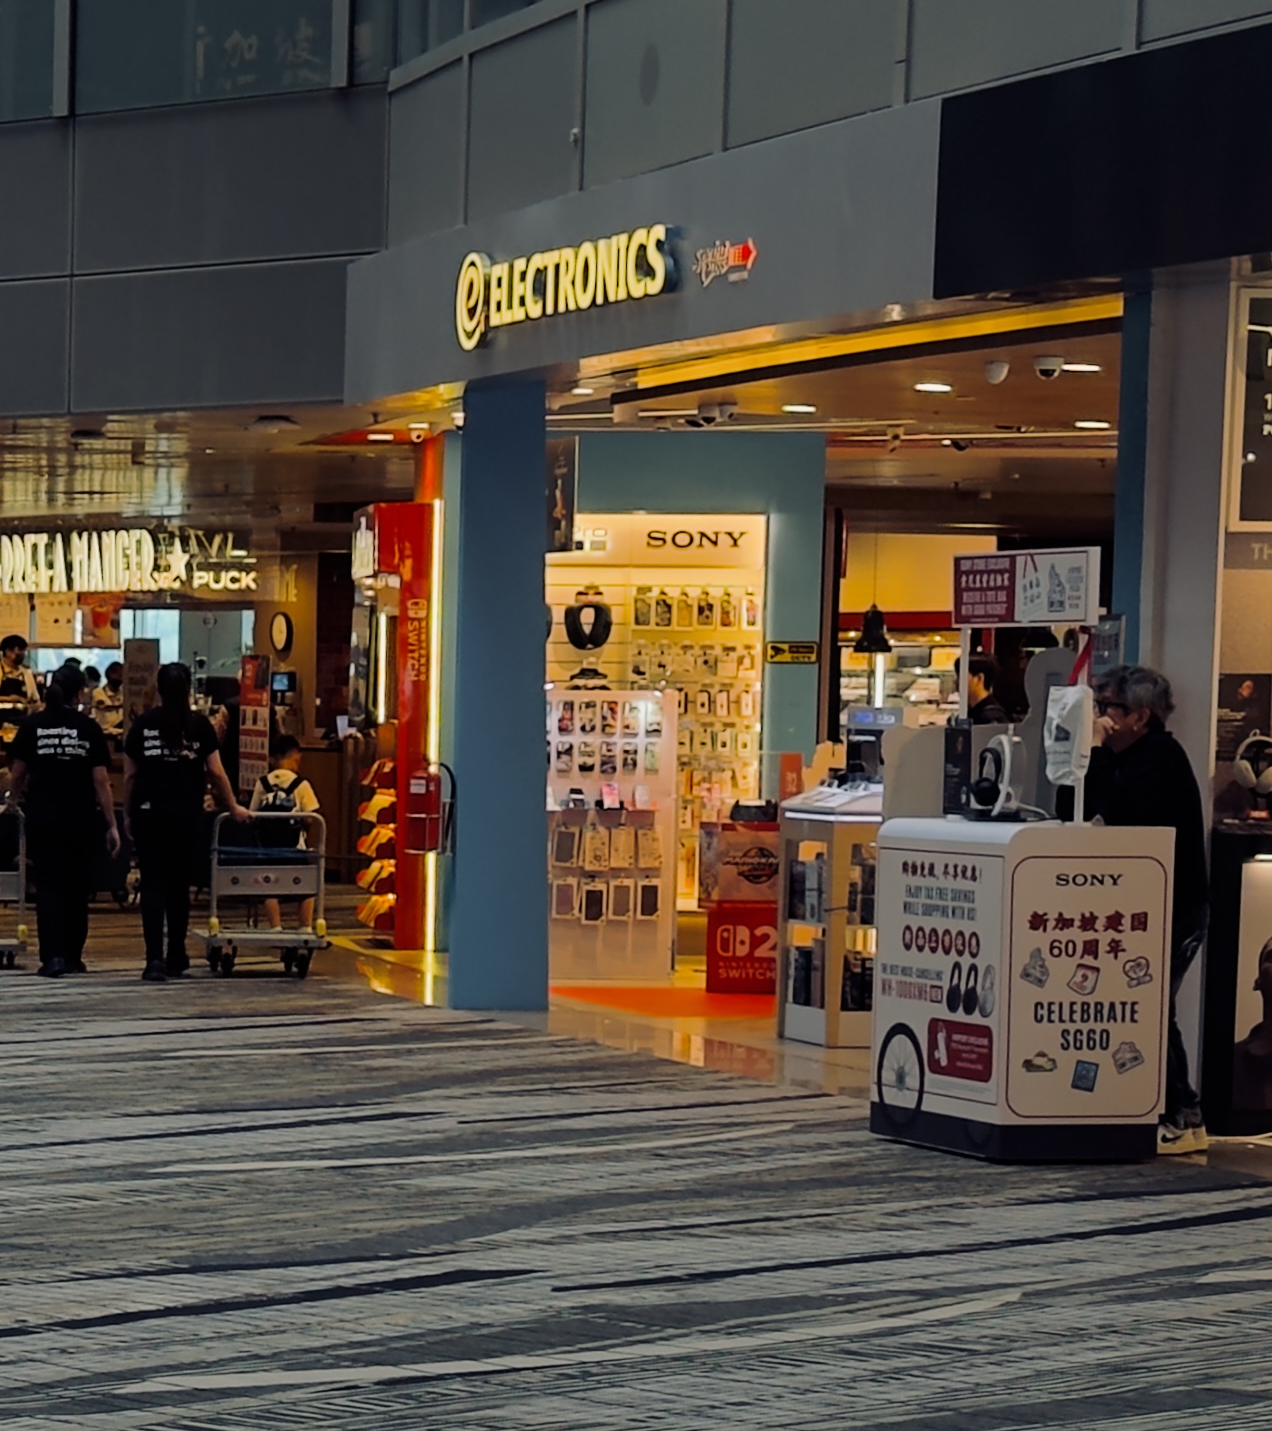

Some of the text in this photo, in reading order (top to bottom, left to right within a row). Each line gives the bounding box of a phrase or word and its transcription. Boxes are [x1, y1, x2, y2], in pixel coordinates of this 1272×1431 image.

[647, 530, 747, 549] SONY
[71, 529, 157, 592] MANGER
[193, 570, 258, 590] PUCK
[407, 620, 419, 681] SWITCH
[1055, 873, 1123, 886] SONY
[1027, 910, 1148, 933] 新加坡建国
[753, 925, 777, 958] 2
[1049, 938, 1127, 960] 60周年
[718, 969, 776, 979] SWITCH
[1033, 1000, 1139, 1024] CELEBRATE
[1060, 1028, 1110, 1051] SG60
